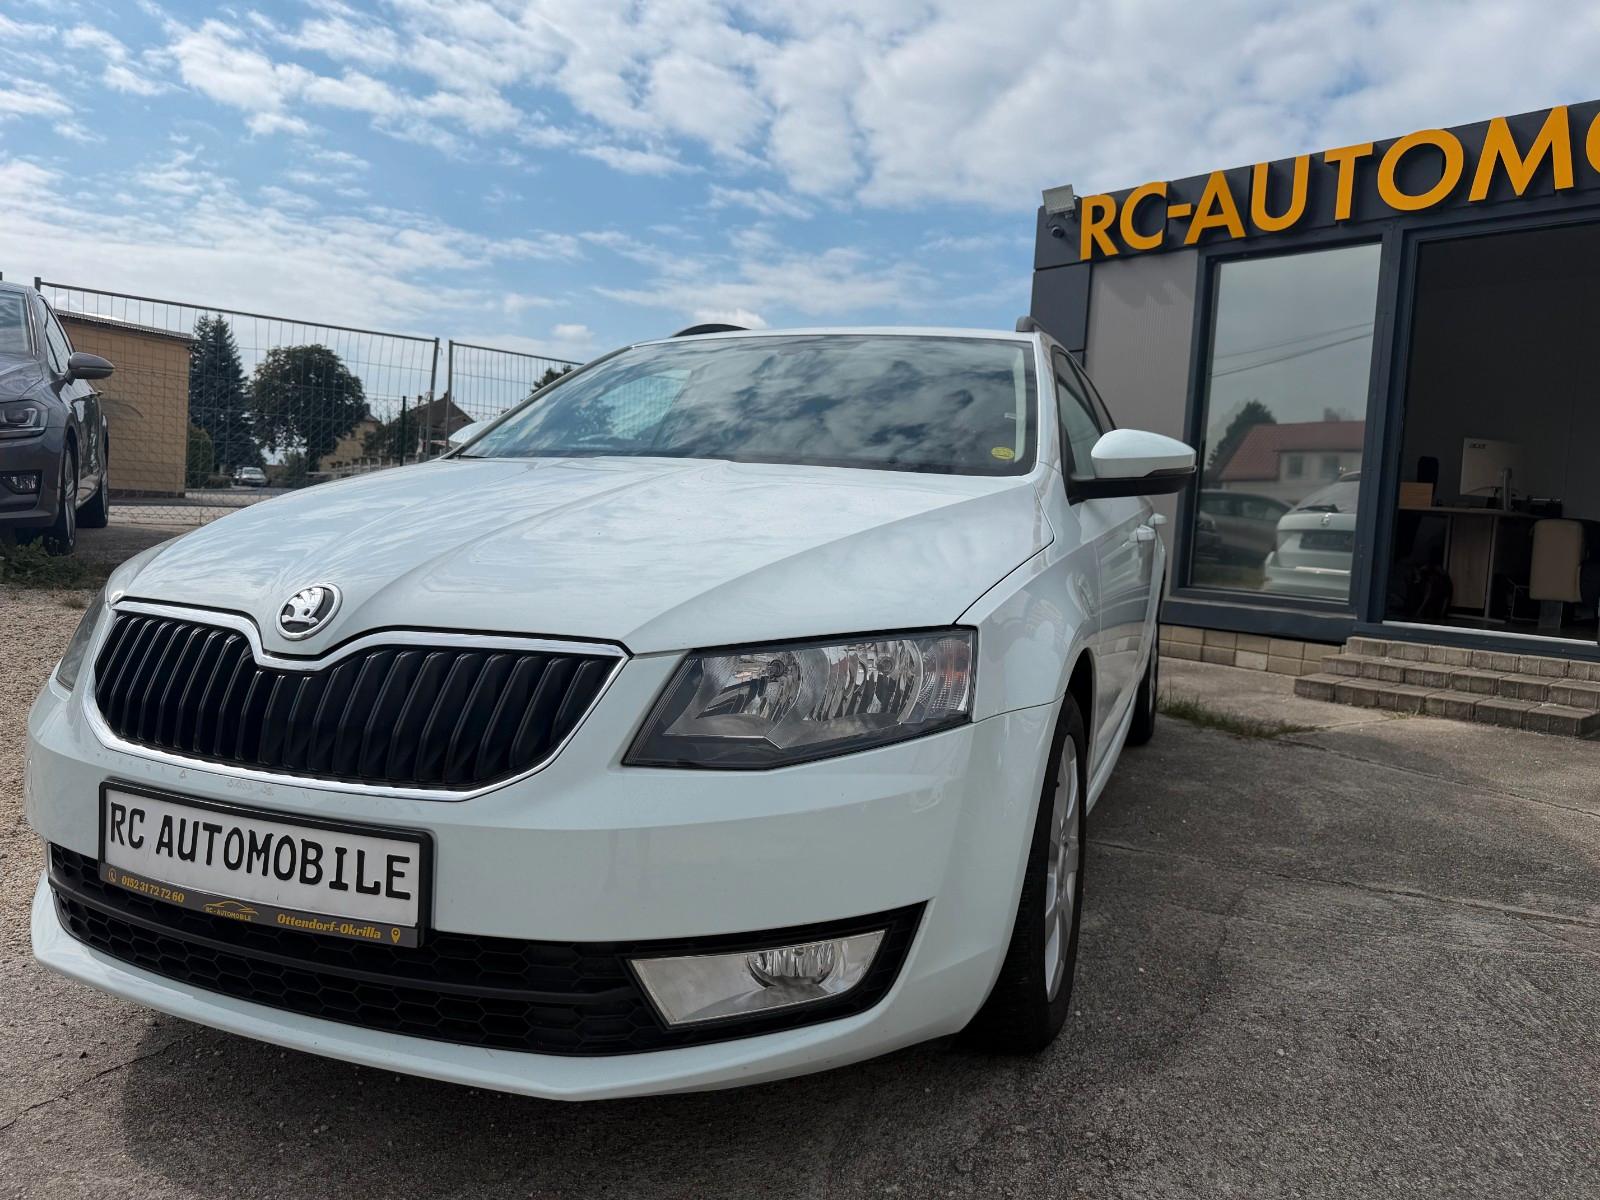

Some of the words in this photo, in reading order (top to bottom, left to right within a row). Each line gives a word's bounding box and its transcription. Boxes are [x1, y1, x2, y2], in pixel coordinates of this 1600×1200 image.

[1080, 104, 1600, 261] RC-AUTOM
[110, 802, 145, 850] RC
[155, 814, 411, 900] AUTOMOBILE
[277, 913, 382, 939] Ottendorf-Okrilla
